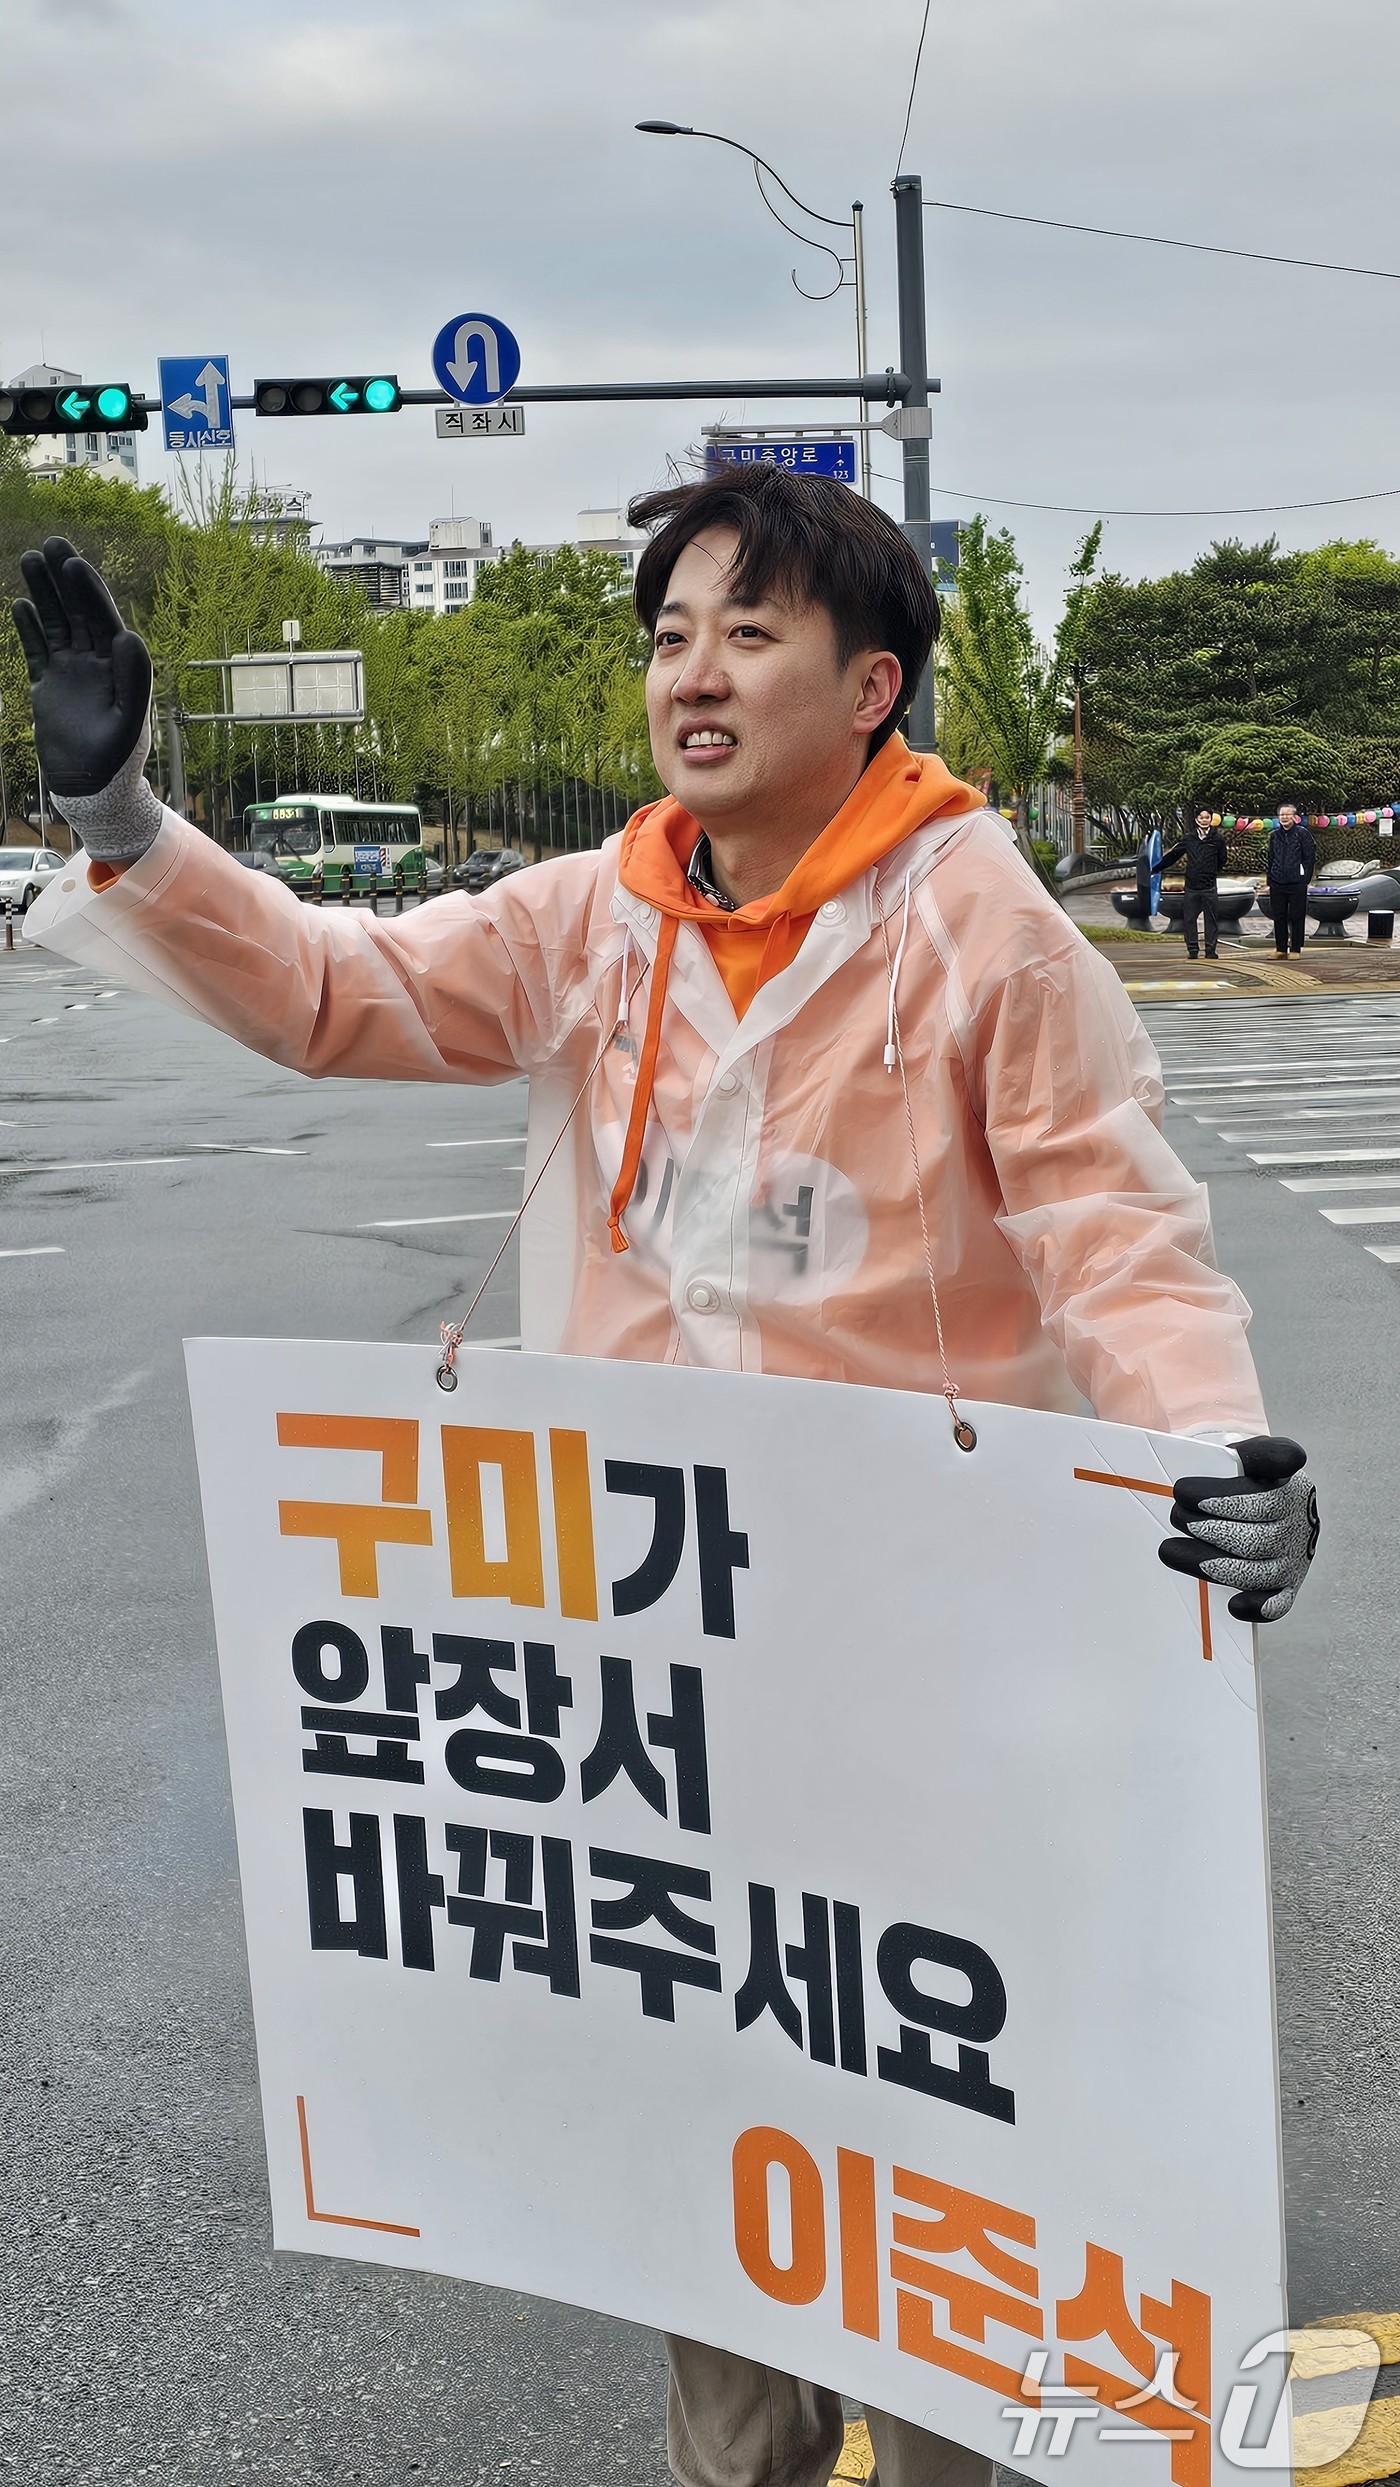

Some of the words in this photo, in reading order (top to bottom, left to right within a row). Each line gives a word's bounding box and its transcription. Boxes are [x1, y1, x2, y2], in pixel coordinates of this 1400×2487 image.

[445, 410, 517, 433] 직좌시
[721, 447, 818, 467] 구미중앙로
[276, 1412, 750, 1640] 구미가
[291, 1620, 711, 1835] 앞장서
[303, 1807, 1016, 2125] 바꿔주세요
[732, 2125, 1212, 2487] 이준석
